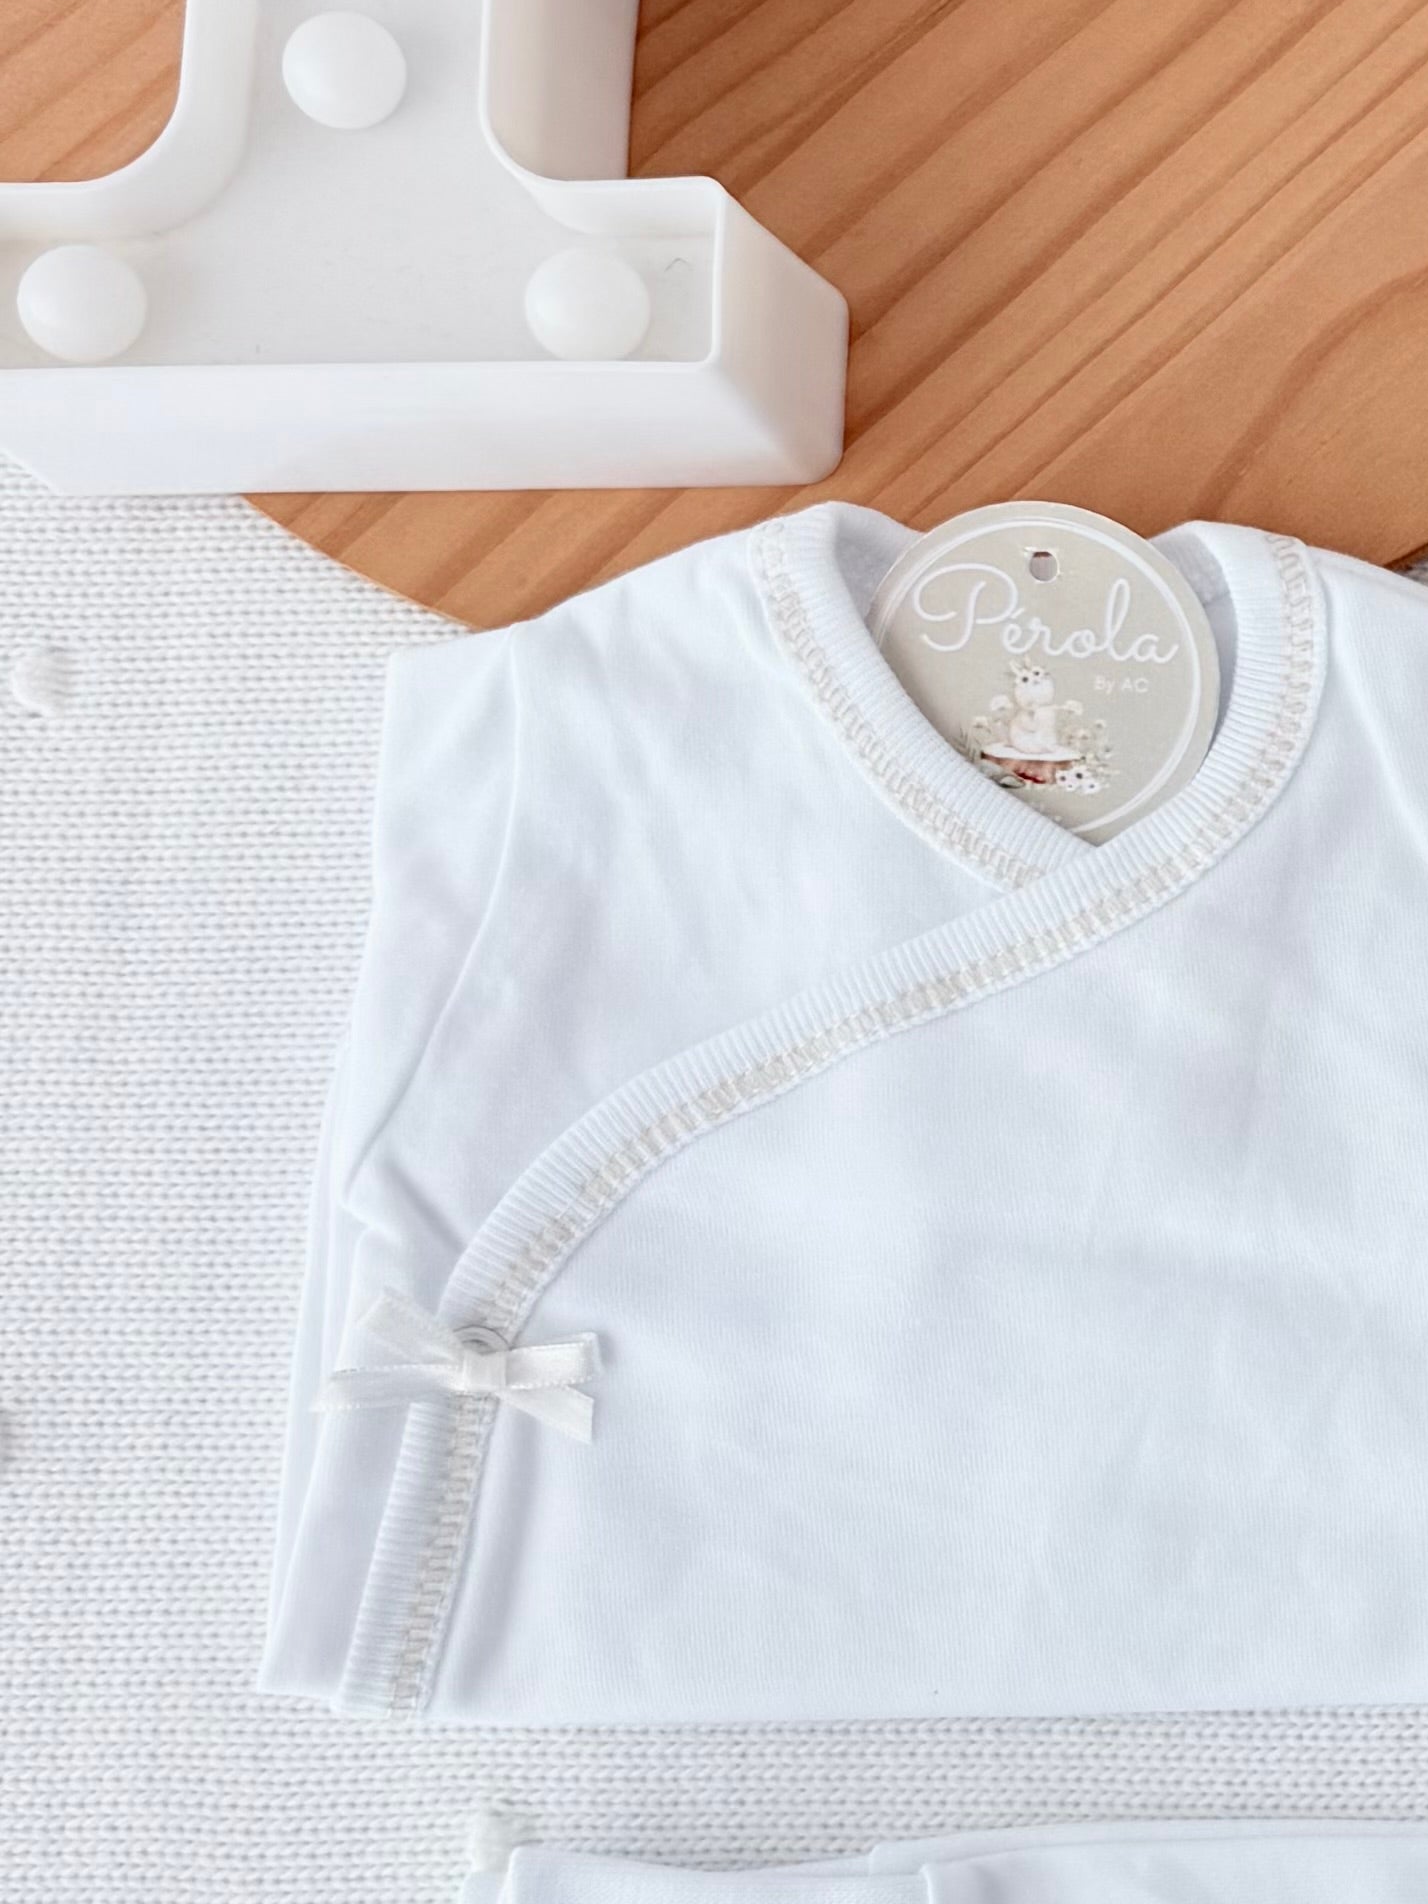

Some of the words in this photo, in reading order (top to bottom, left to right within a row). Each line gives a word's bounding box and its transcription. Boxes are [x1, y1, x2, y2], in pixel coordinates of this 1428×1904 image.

[913, 562, 1179, 664] Pérola
[1094, 675, 1115, 694] By
[1121, 677, 1149, 693] AC
